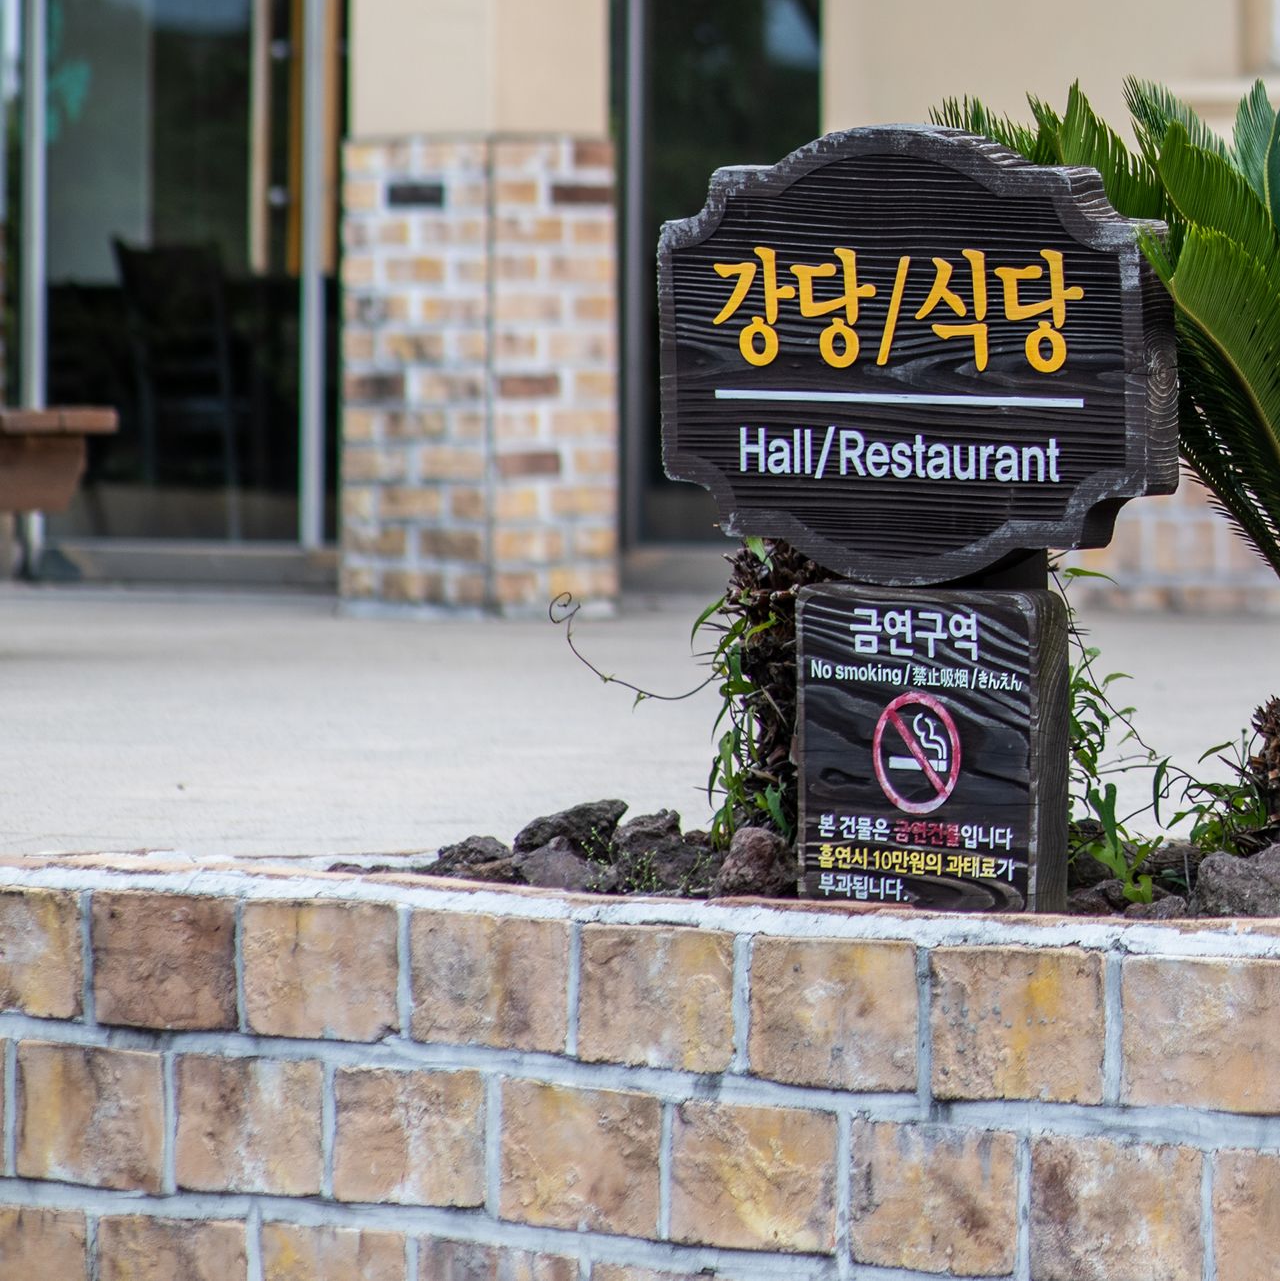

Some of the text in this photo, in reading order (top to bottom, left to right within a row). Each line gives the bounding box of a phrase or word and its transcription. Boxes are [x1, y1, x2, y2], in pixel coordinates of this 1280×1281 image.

[712, 245, 1085, 374] 강당/식당
[739, 425, 1061, 484] Hall/Restaurant
[849, 607, 979, 662] 금연구역
[811, 659, 832, 680] No
[817, 813, 836, 838] 본
[839, 815, 891, 842] 건물은
[817, 843, 1015, 882] 흡연시 10만원의 과태료가
[817, 872, 910, 903] 부과됩니다.
